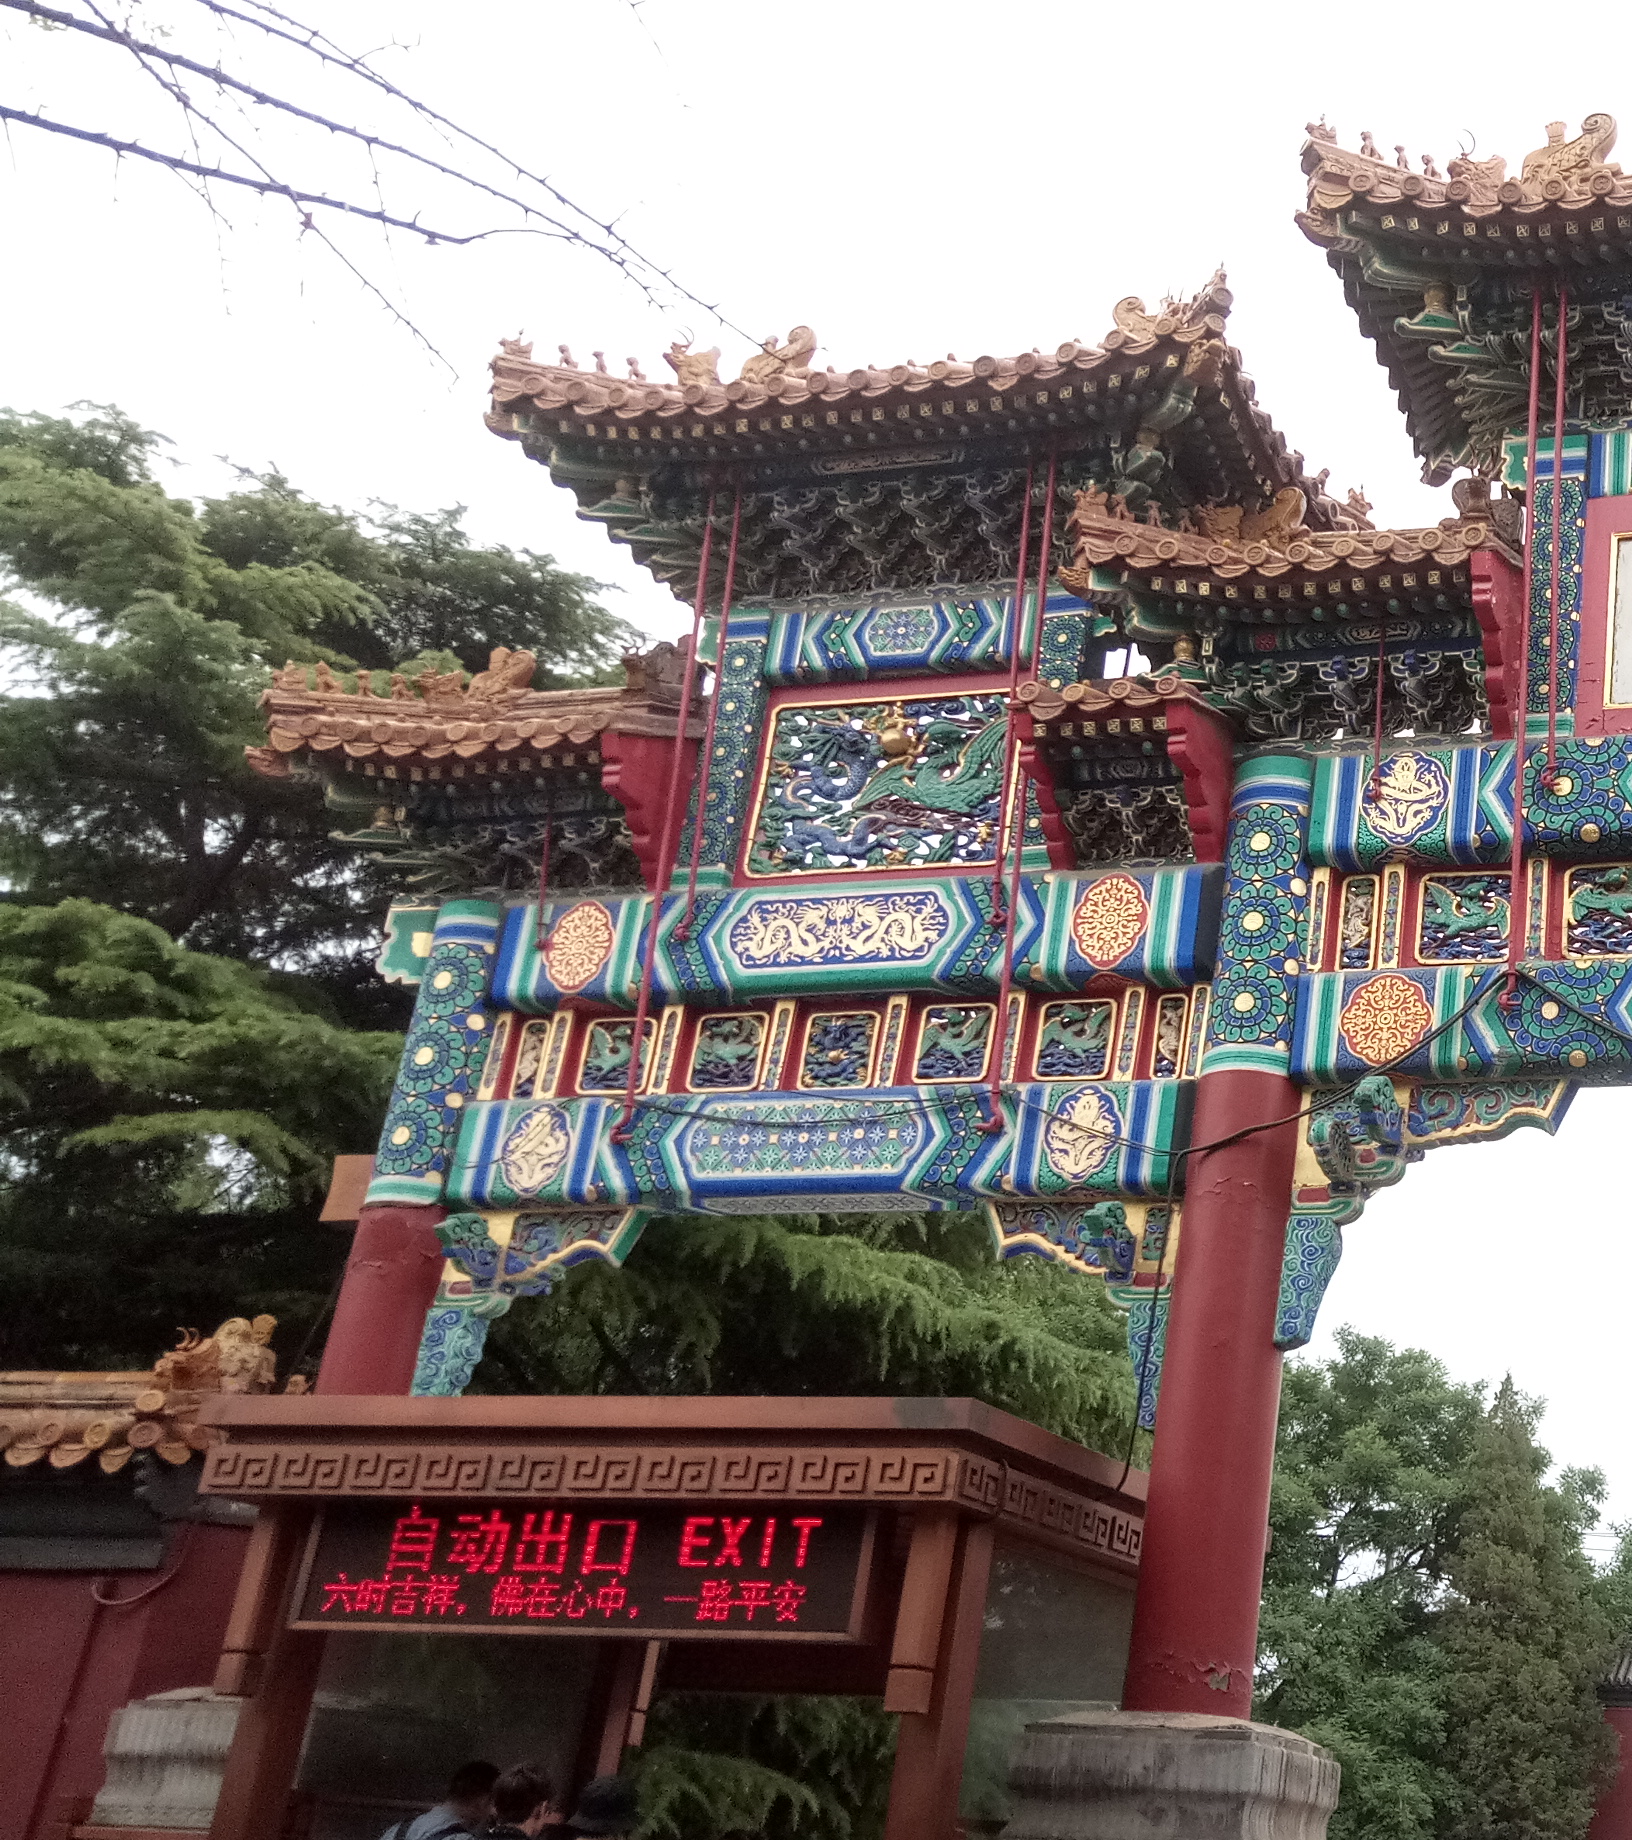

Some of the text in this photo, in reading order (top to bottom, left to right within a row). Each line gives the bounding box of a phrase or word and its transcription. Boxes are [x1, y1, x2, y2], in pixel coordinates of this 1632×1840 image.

[386, 1506, 822, 1575] 自动出口 EXIT
